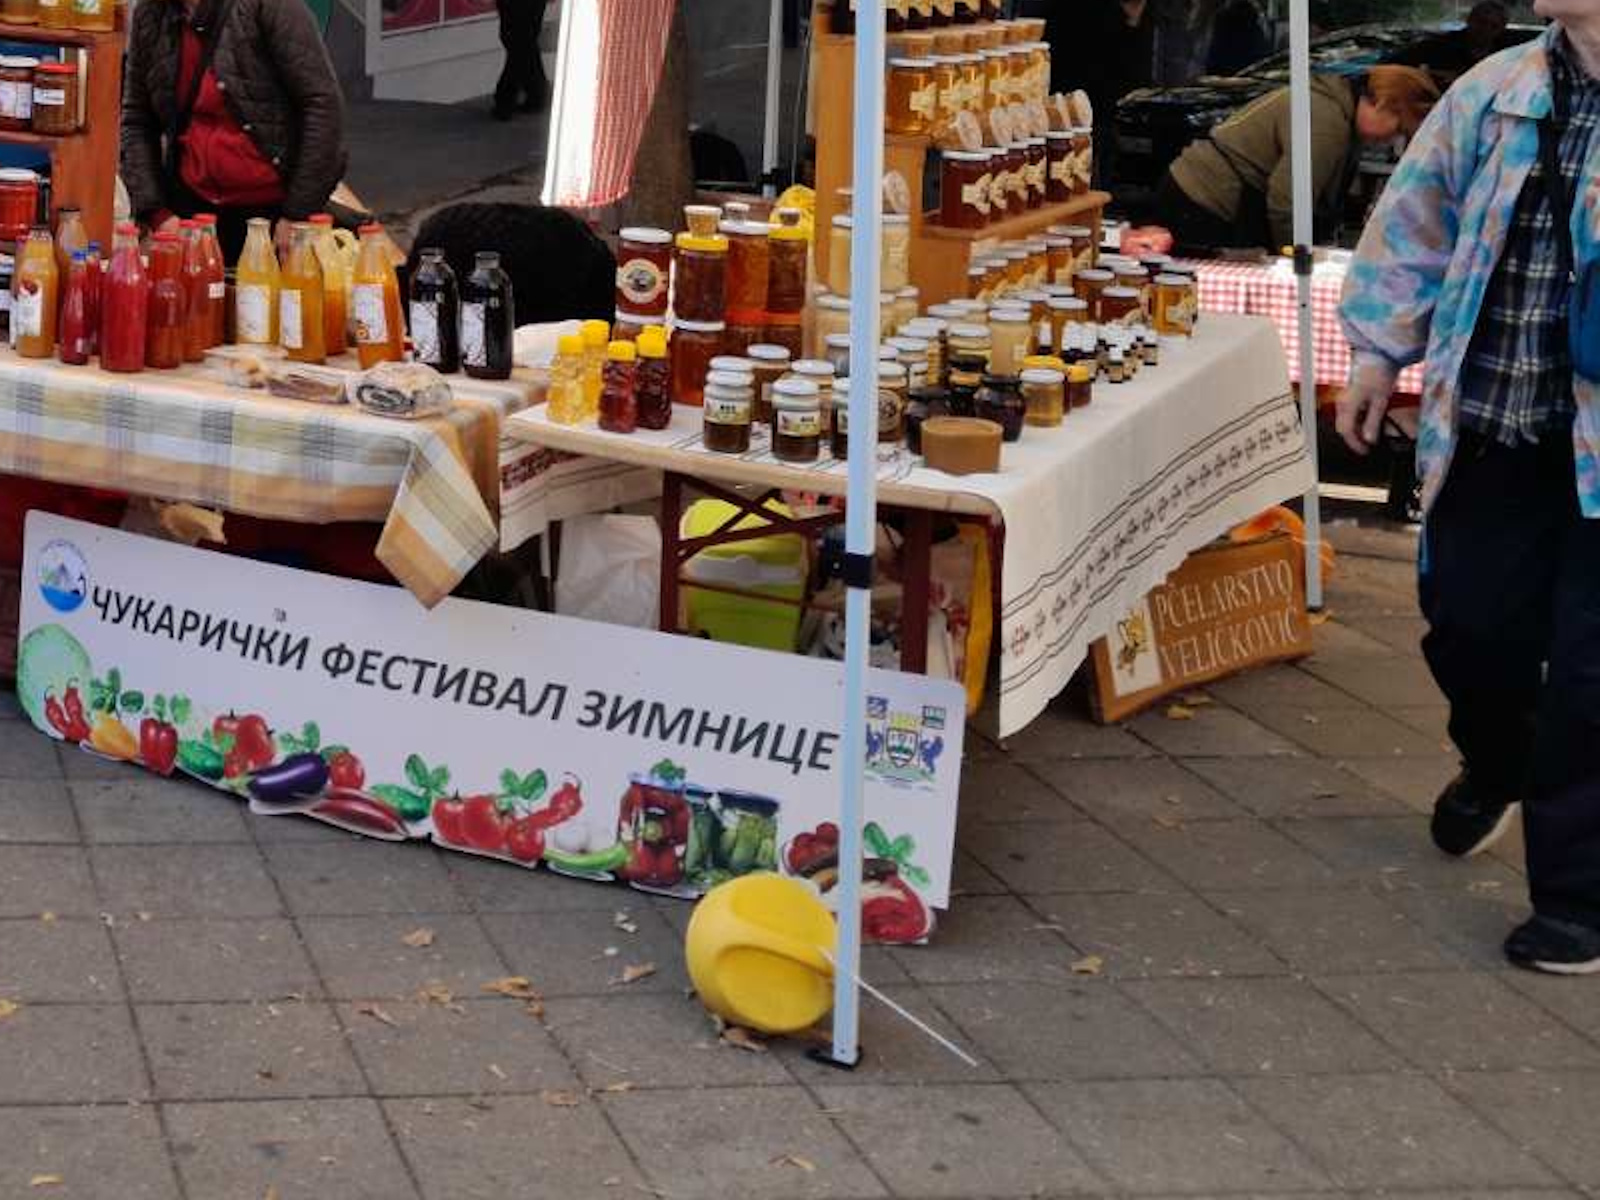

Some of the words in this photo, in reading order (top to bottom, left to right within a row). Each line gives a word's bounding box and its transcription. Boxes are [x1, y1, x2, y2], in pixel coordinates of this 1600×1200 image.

[91, 585, 311, 671] ЧУКАРИЧКИ
[320, 642, 567, 721] ФЕСТИВАЛ
[577, 689, 840, 775] ЗИМНИЦЕ
